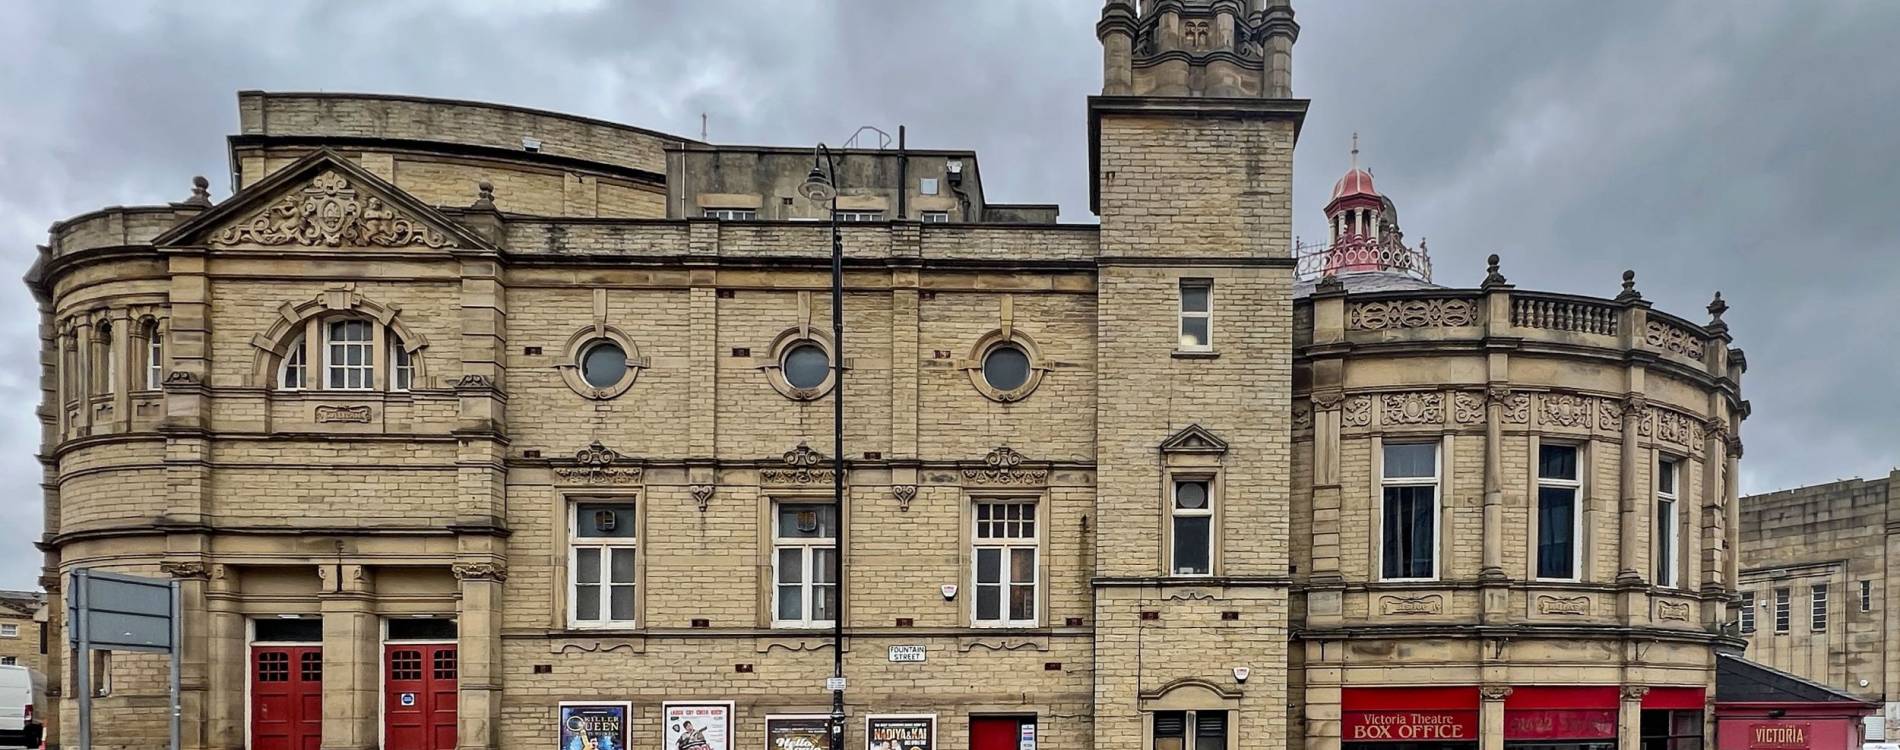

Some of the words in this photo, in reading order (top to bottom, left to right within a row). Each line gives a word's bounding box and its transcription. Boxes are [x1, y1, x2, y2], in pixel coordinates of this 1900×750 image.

[566, 715, 619, 732] QUEEN
[1364, 713, 1407, 725] Victoria
[1410, 713, 1454, 725] Theatre
[1354, 725, 1393, 739] BOX
[1398, 724, 1464, 739] OFFICE
[1755, 727, 1804, 743] VICTORIA
